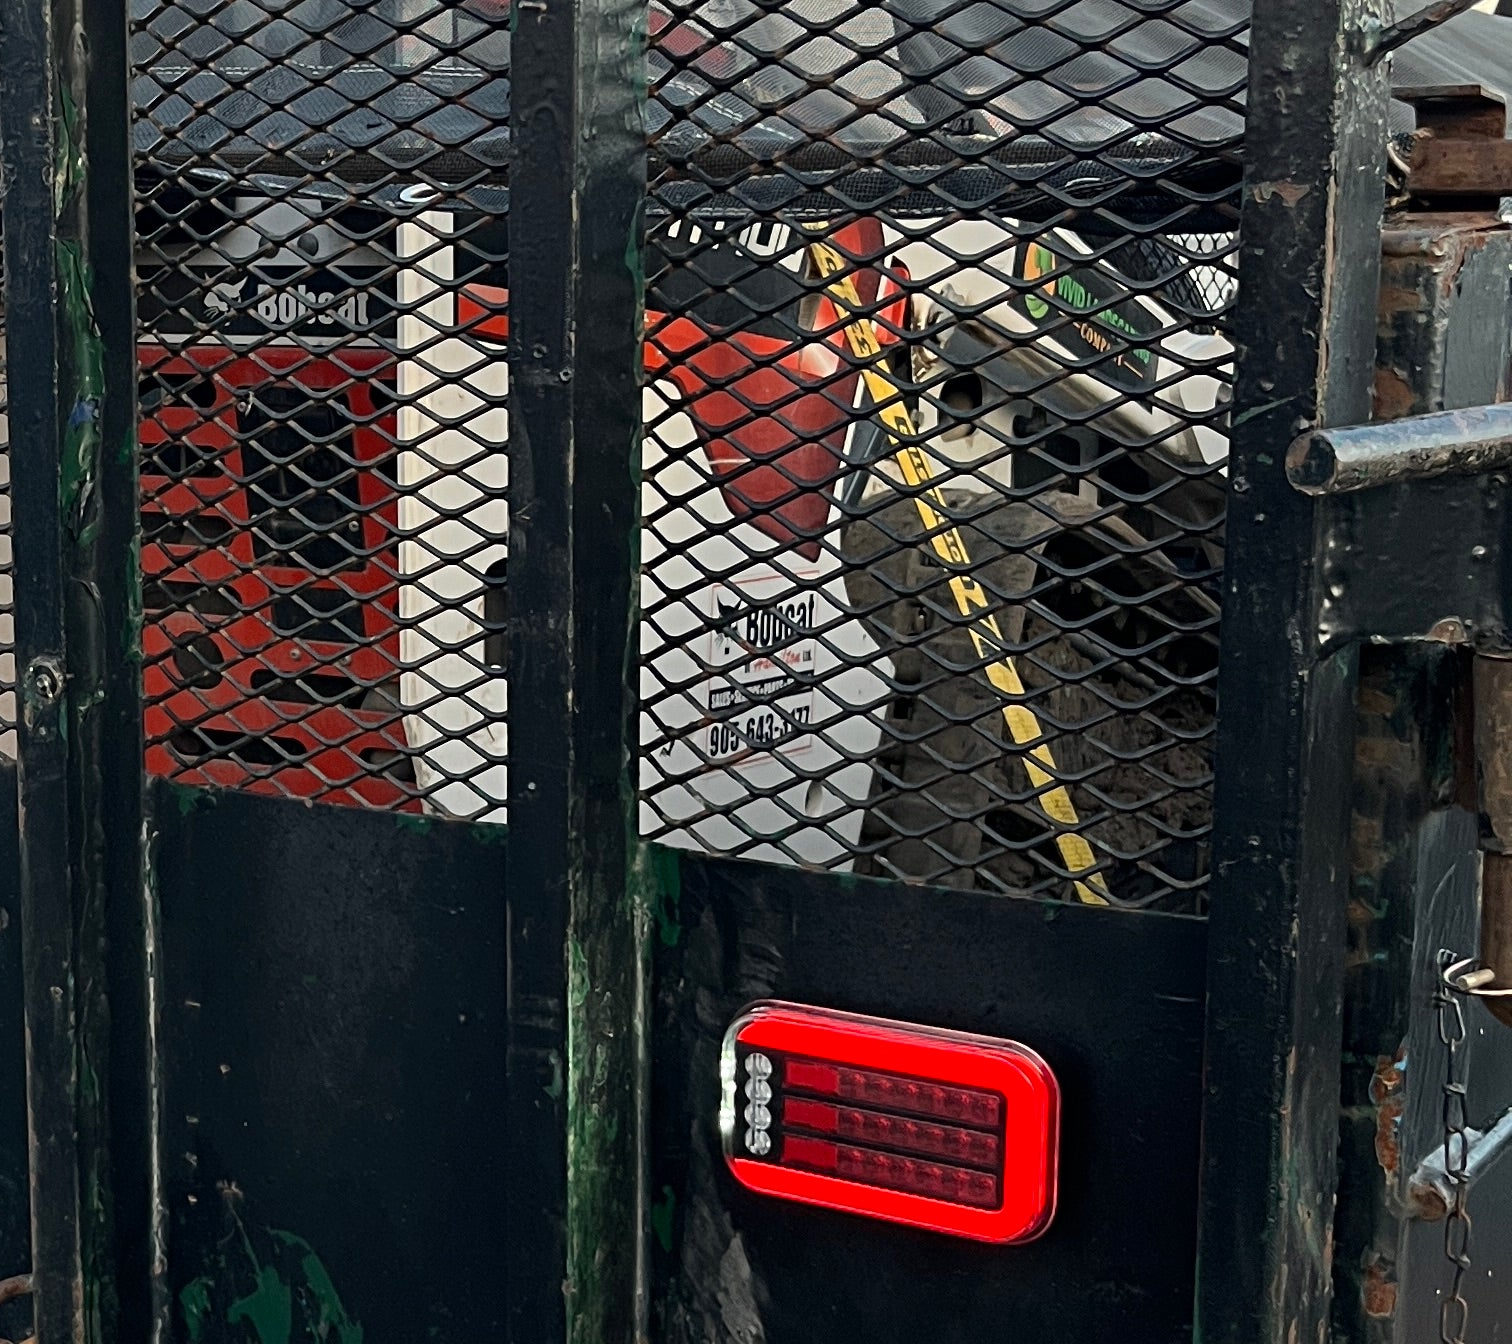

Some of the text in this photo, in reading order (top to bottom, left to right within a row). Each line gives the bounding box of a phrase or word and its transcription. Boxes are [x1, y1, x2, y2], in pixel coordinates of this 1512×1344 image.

[257, 284, 369, 325] Bobcat
[1058, 274, 1085, 308] VIVID
[746, 594, 815, 648] Bobcat
